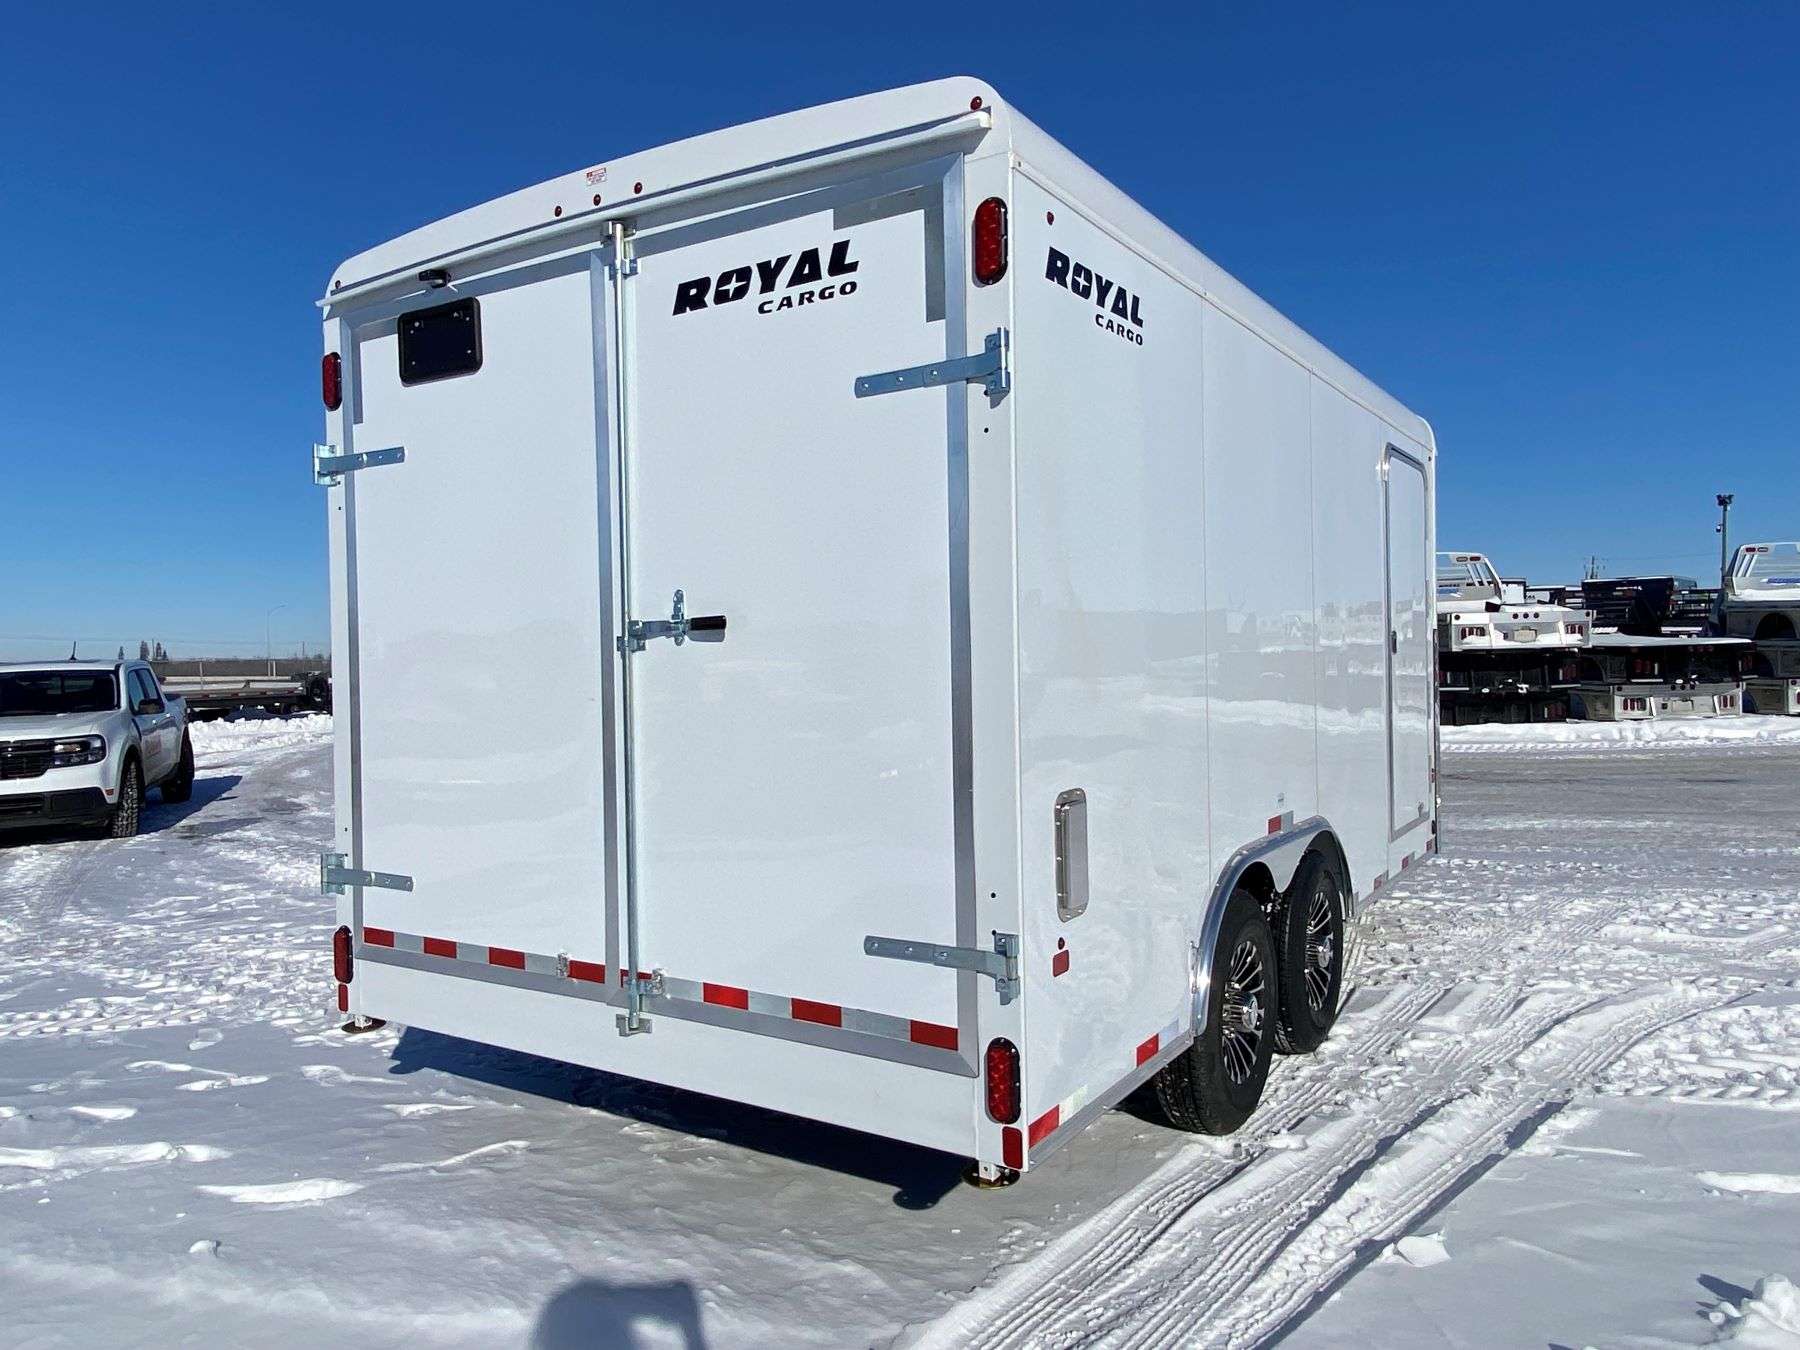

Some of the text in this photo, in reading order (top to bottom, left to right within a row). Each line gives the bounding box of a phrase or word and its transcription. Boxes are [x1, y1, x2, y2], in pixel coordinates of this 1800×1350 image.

[672, 239, 860, 316] ROYAL
[757, 281, 858, 315] CARGO
[1045, 245, 1144, 328] ROYAL
[1095, 313, 1143, 346] CARGO
